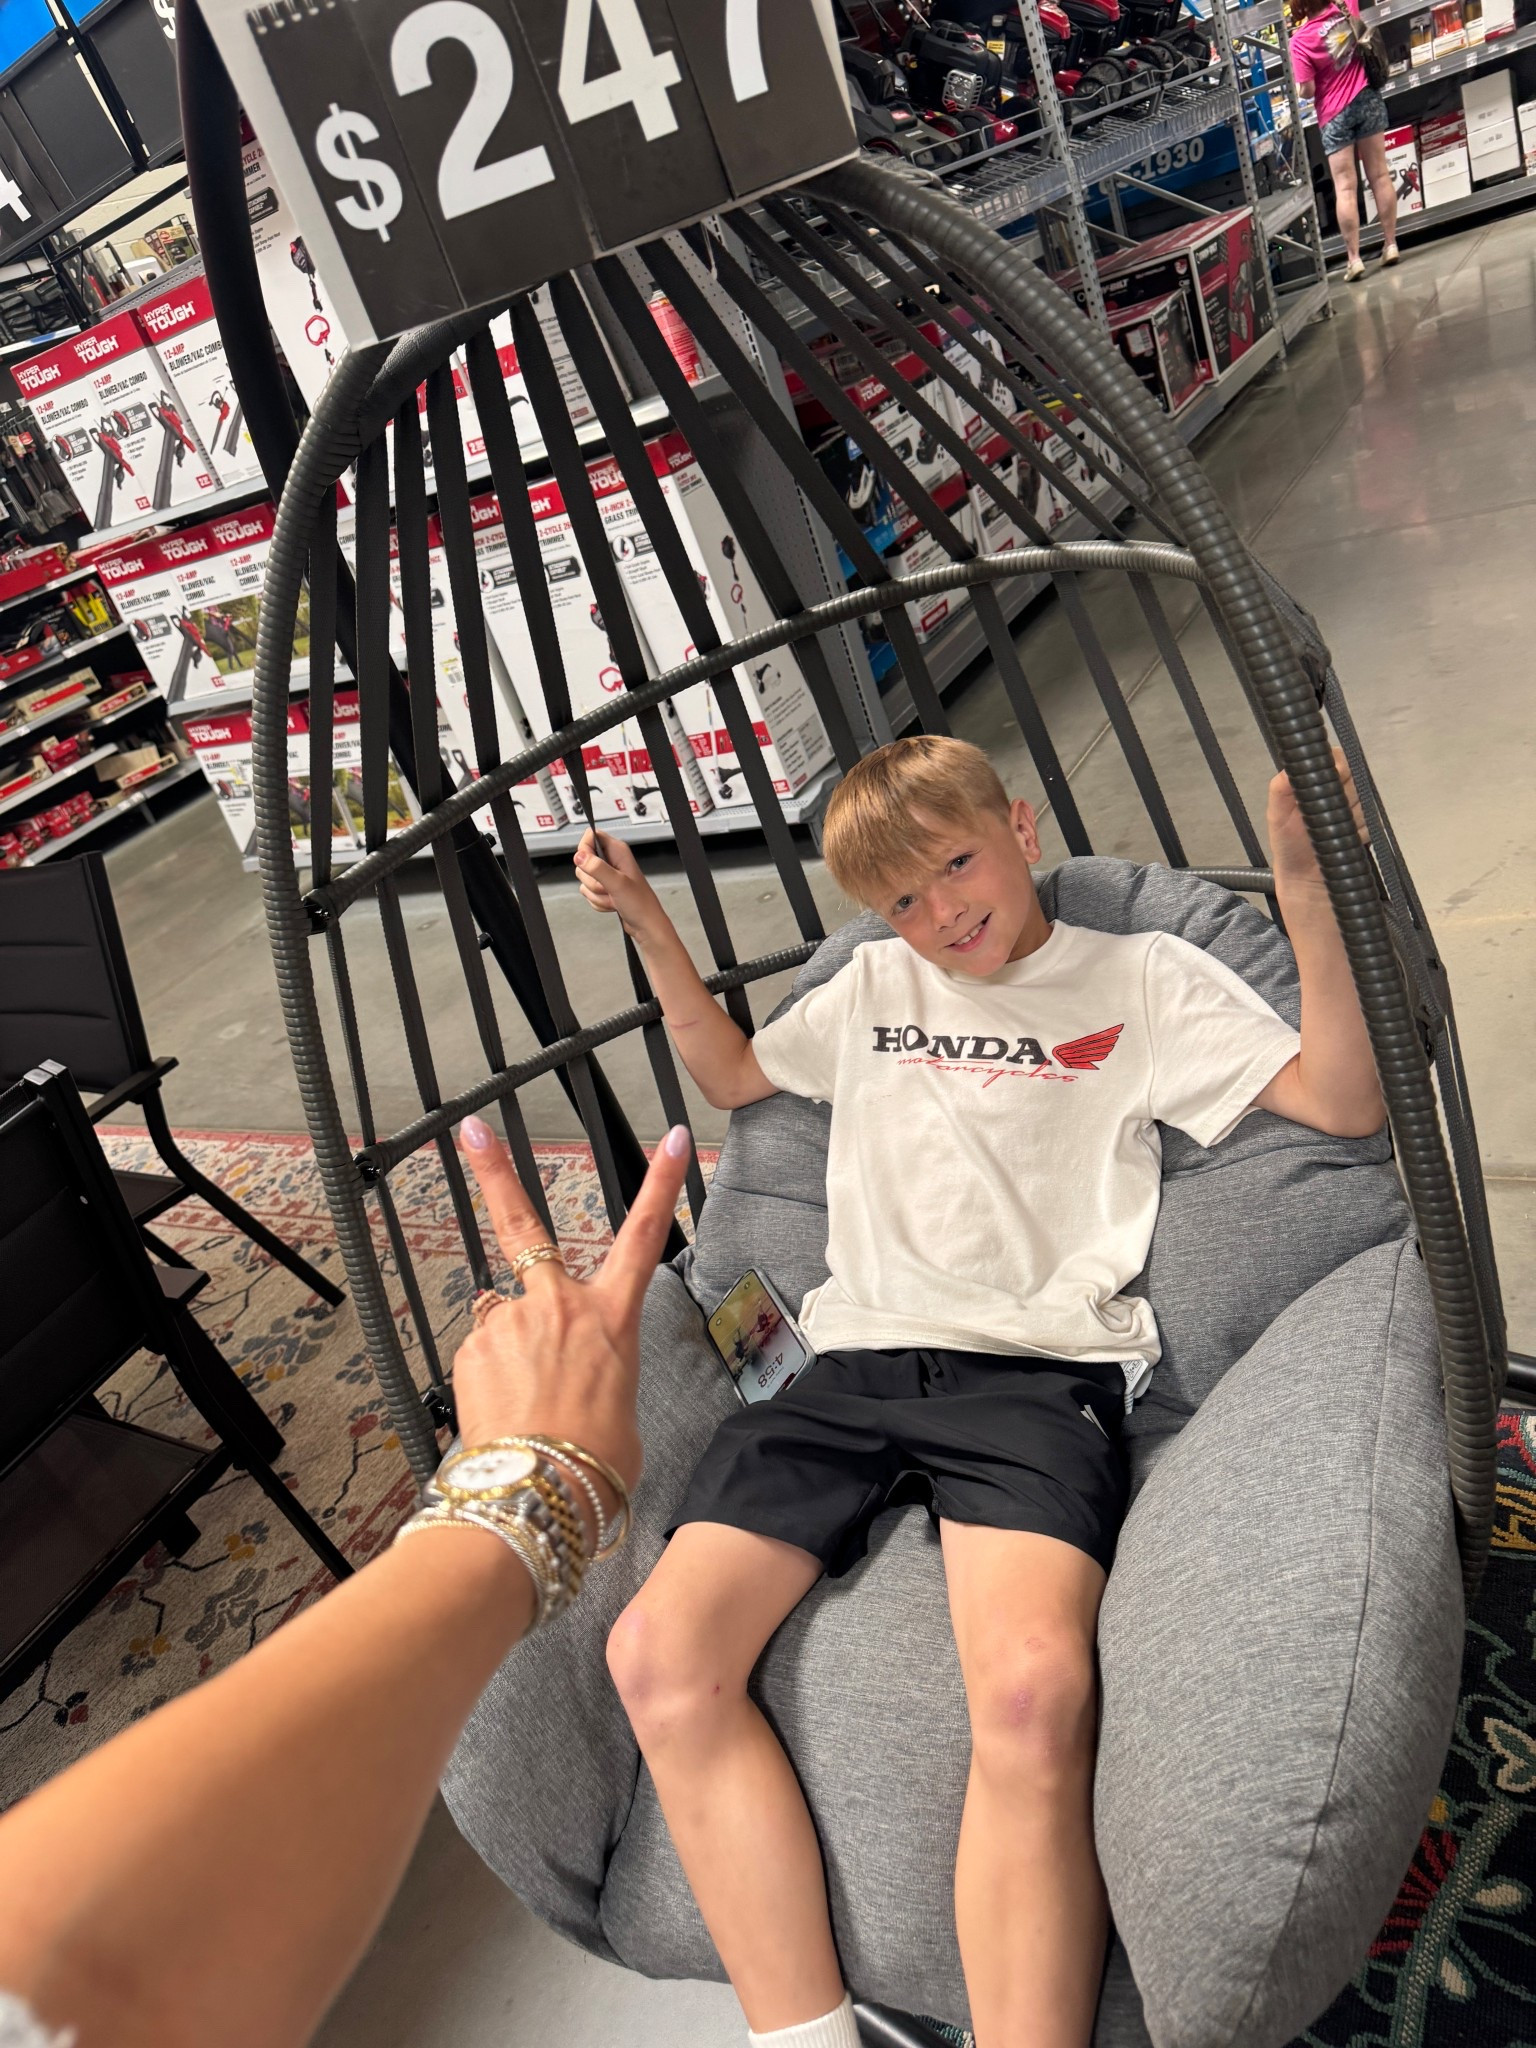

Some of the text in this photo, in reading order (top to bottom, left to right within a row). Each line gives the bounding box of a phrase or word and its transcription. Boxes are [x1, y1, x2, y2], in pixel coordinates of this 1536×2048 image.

[1099, 136, 1204, 194] -1930
[143, 302, 172, 322] HYPER
[147, 300, 196, 334] TOUGH
[73, 335, 98, 353] HYPER
[77, 334, 119, 364] TOUGH
[163, 342, 185, 360] 12-AMP
[204, 340, 223, 356] COMB
[17, 364, 41, 381] HYPER
[20, 363, 61, 391] TOUGH
[93, 373, 112, 389] 12-AMP
[36, 400, 54, 415] 12-AMP
[590, 470, 625, 492] TOU
[470, 504, 499, 523] UGH
[604, 510, 624, 525] GRASS
[212, 520, 241, 536] HYPER
[215, 519, 265, 545] TOUGH
[159, 537, 185, 552] HYPER
[161, 537, 209, 561] TOUGH
[100, 557, 123, 571] HYPER
[101, 557, 145, 581] TOUGH
[190, 727, 232, 744] TOUGH
[872, 1024, 1052, 1066] HONDA
[758, 1352, 784, 1388] 4:58
